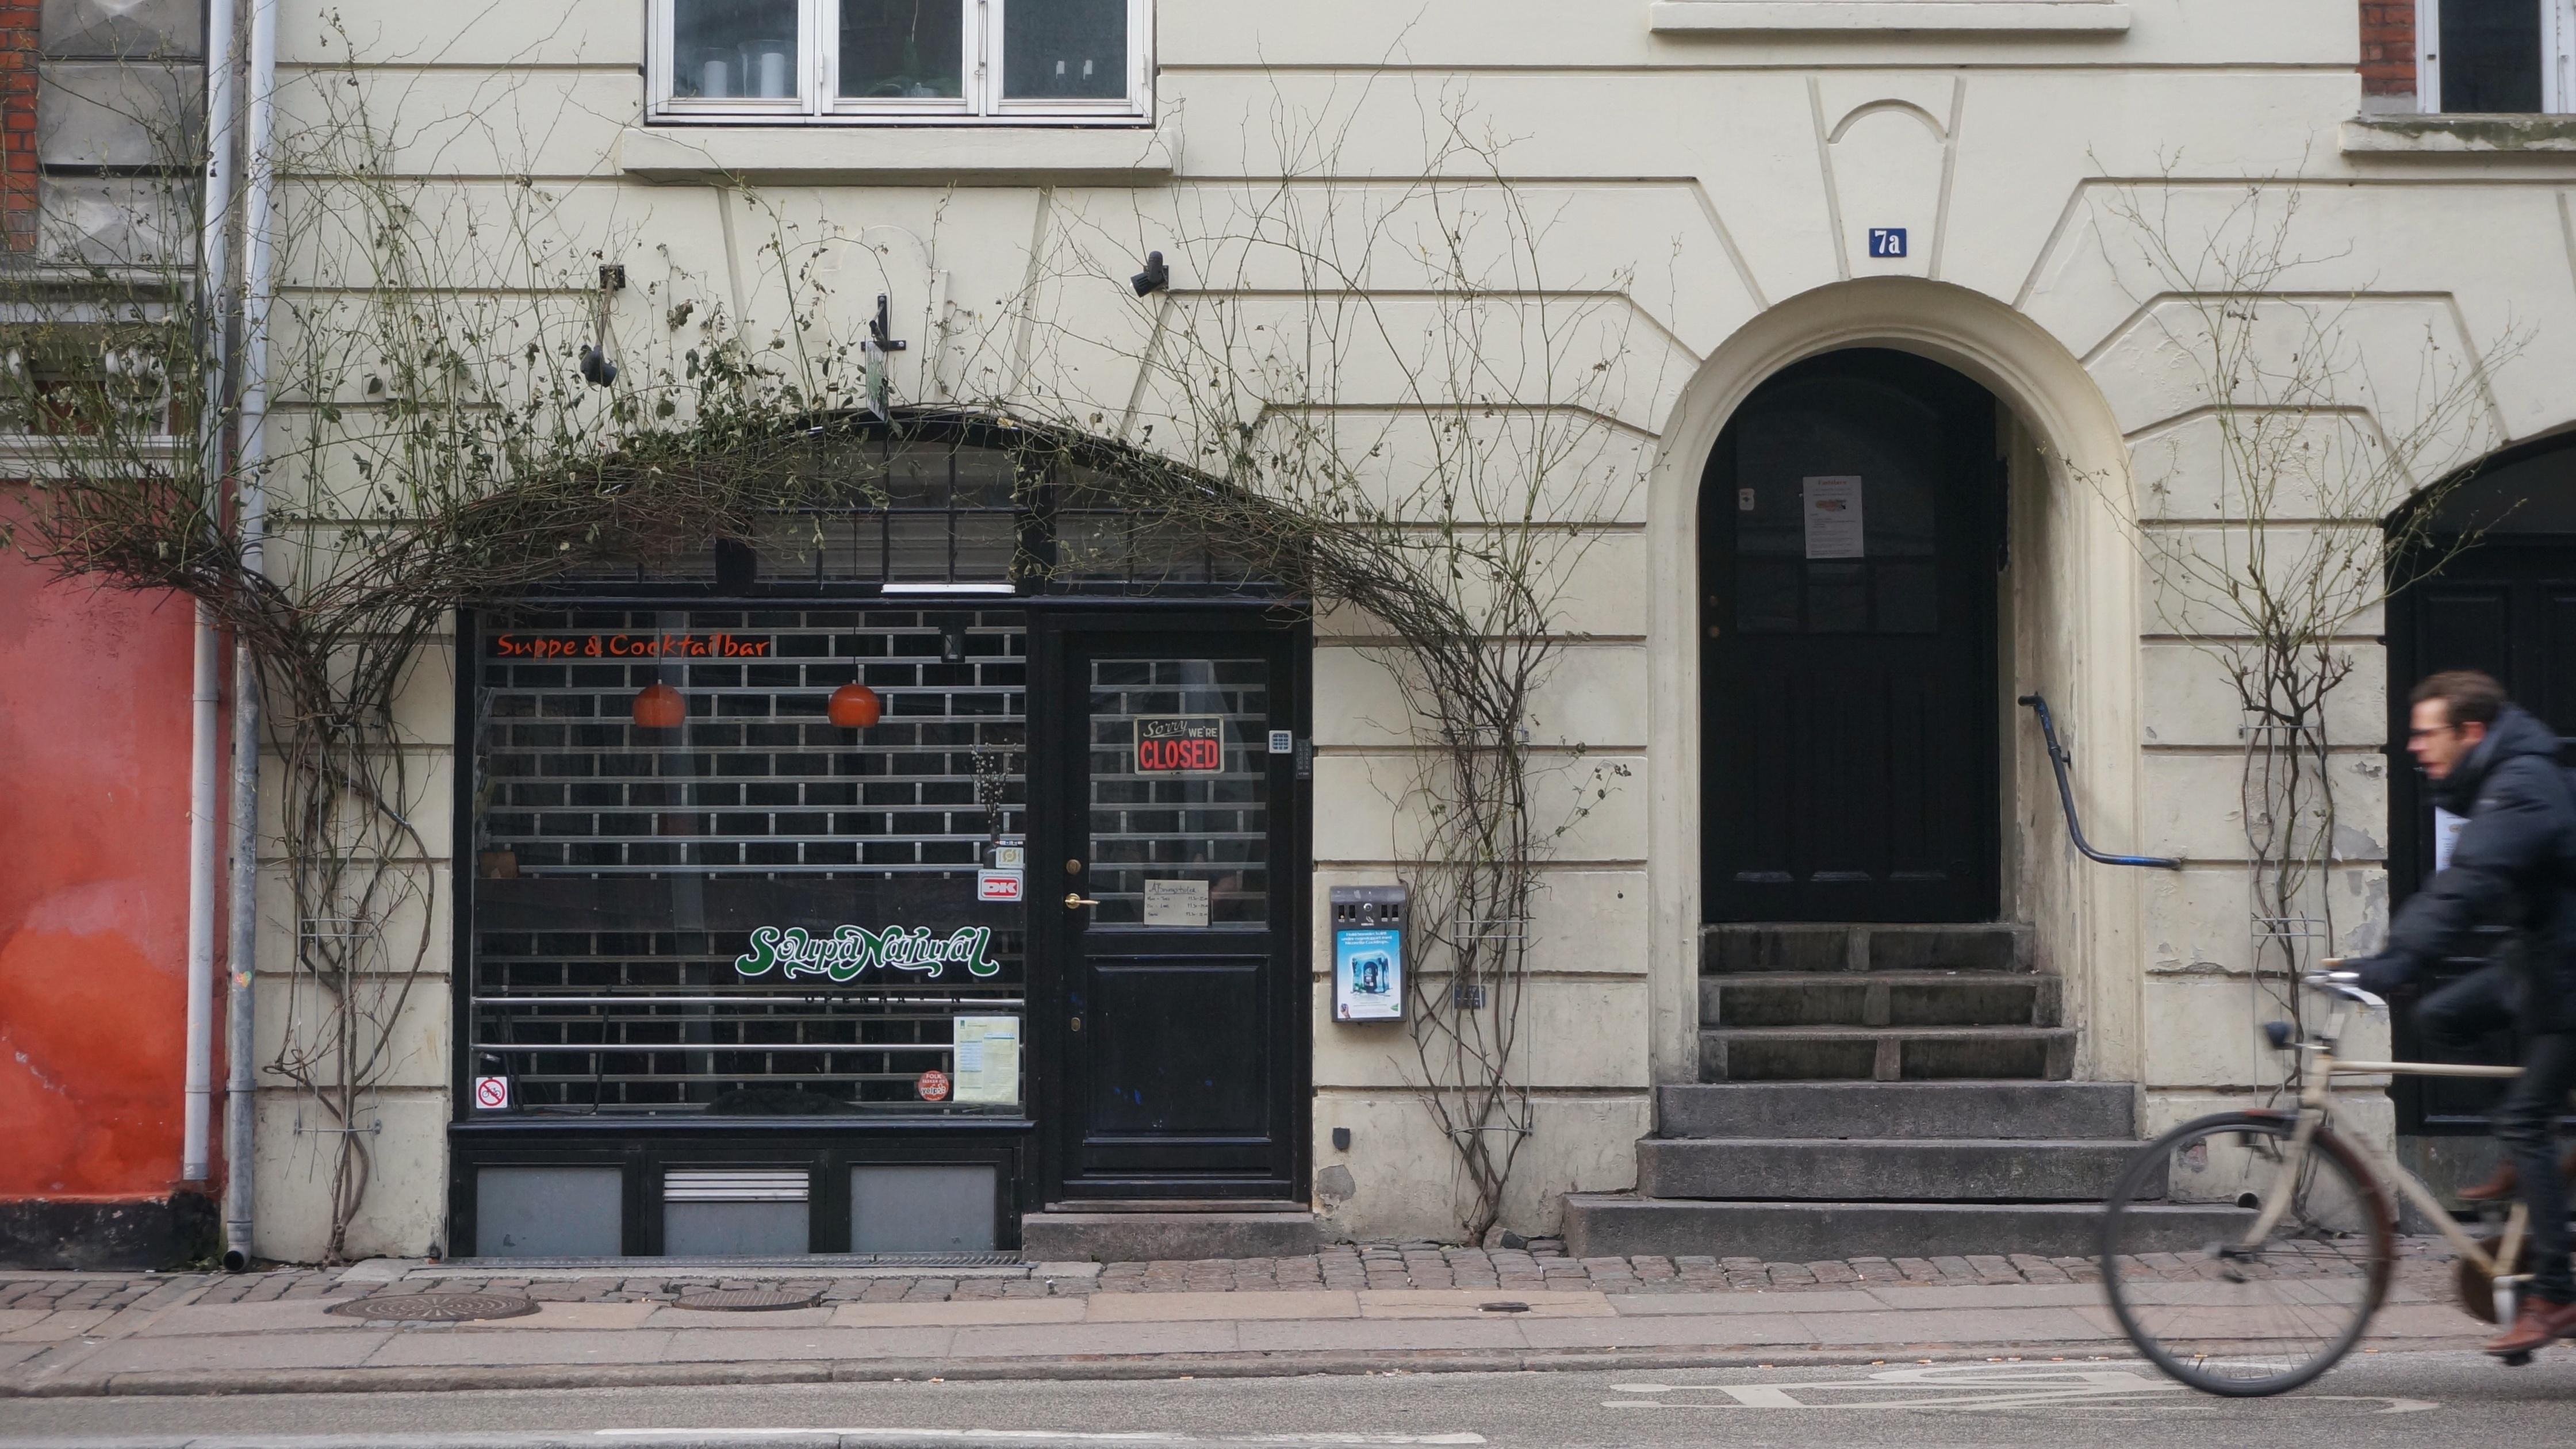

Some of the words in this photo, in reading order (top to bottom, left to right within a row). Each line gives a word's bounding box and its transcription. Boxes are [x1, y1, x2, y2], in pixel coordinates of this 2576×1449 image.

[1875, 230, 1900, 254] 7a
[497, 634, 575, 662] Suppe
[584, 634, 603, 656] &
[610, 632, 770, 658] Cocktailbar
[1143, 720, 1187, 738] Sorry
[1140, 739, 1218, 769] CLOSED
[983, 882, 1017, 893] DK
[921, 1087, 938, 1095] yelp
